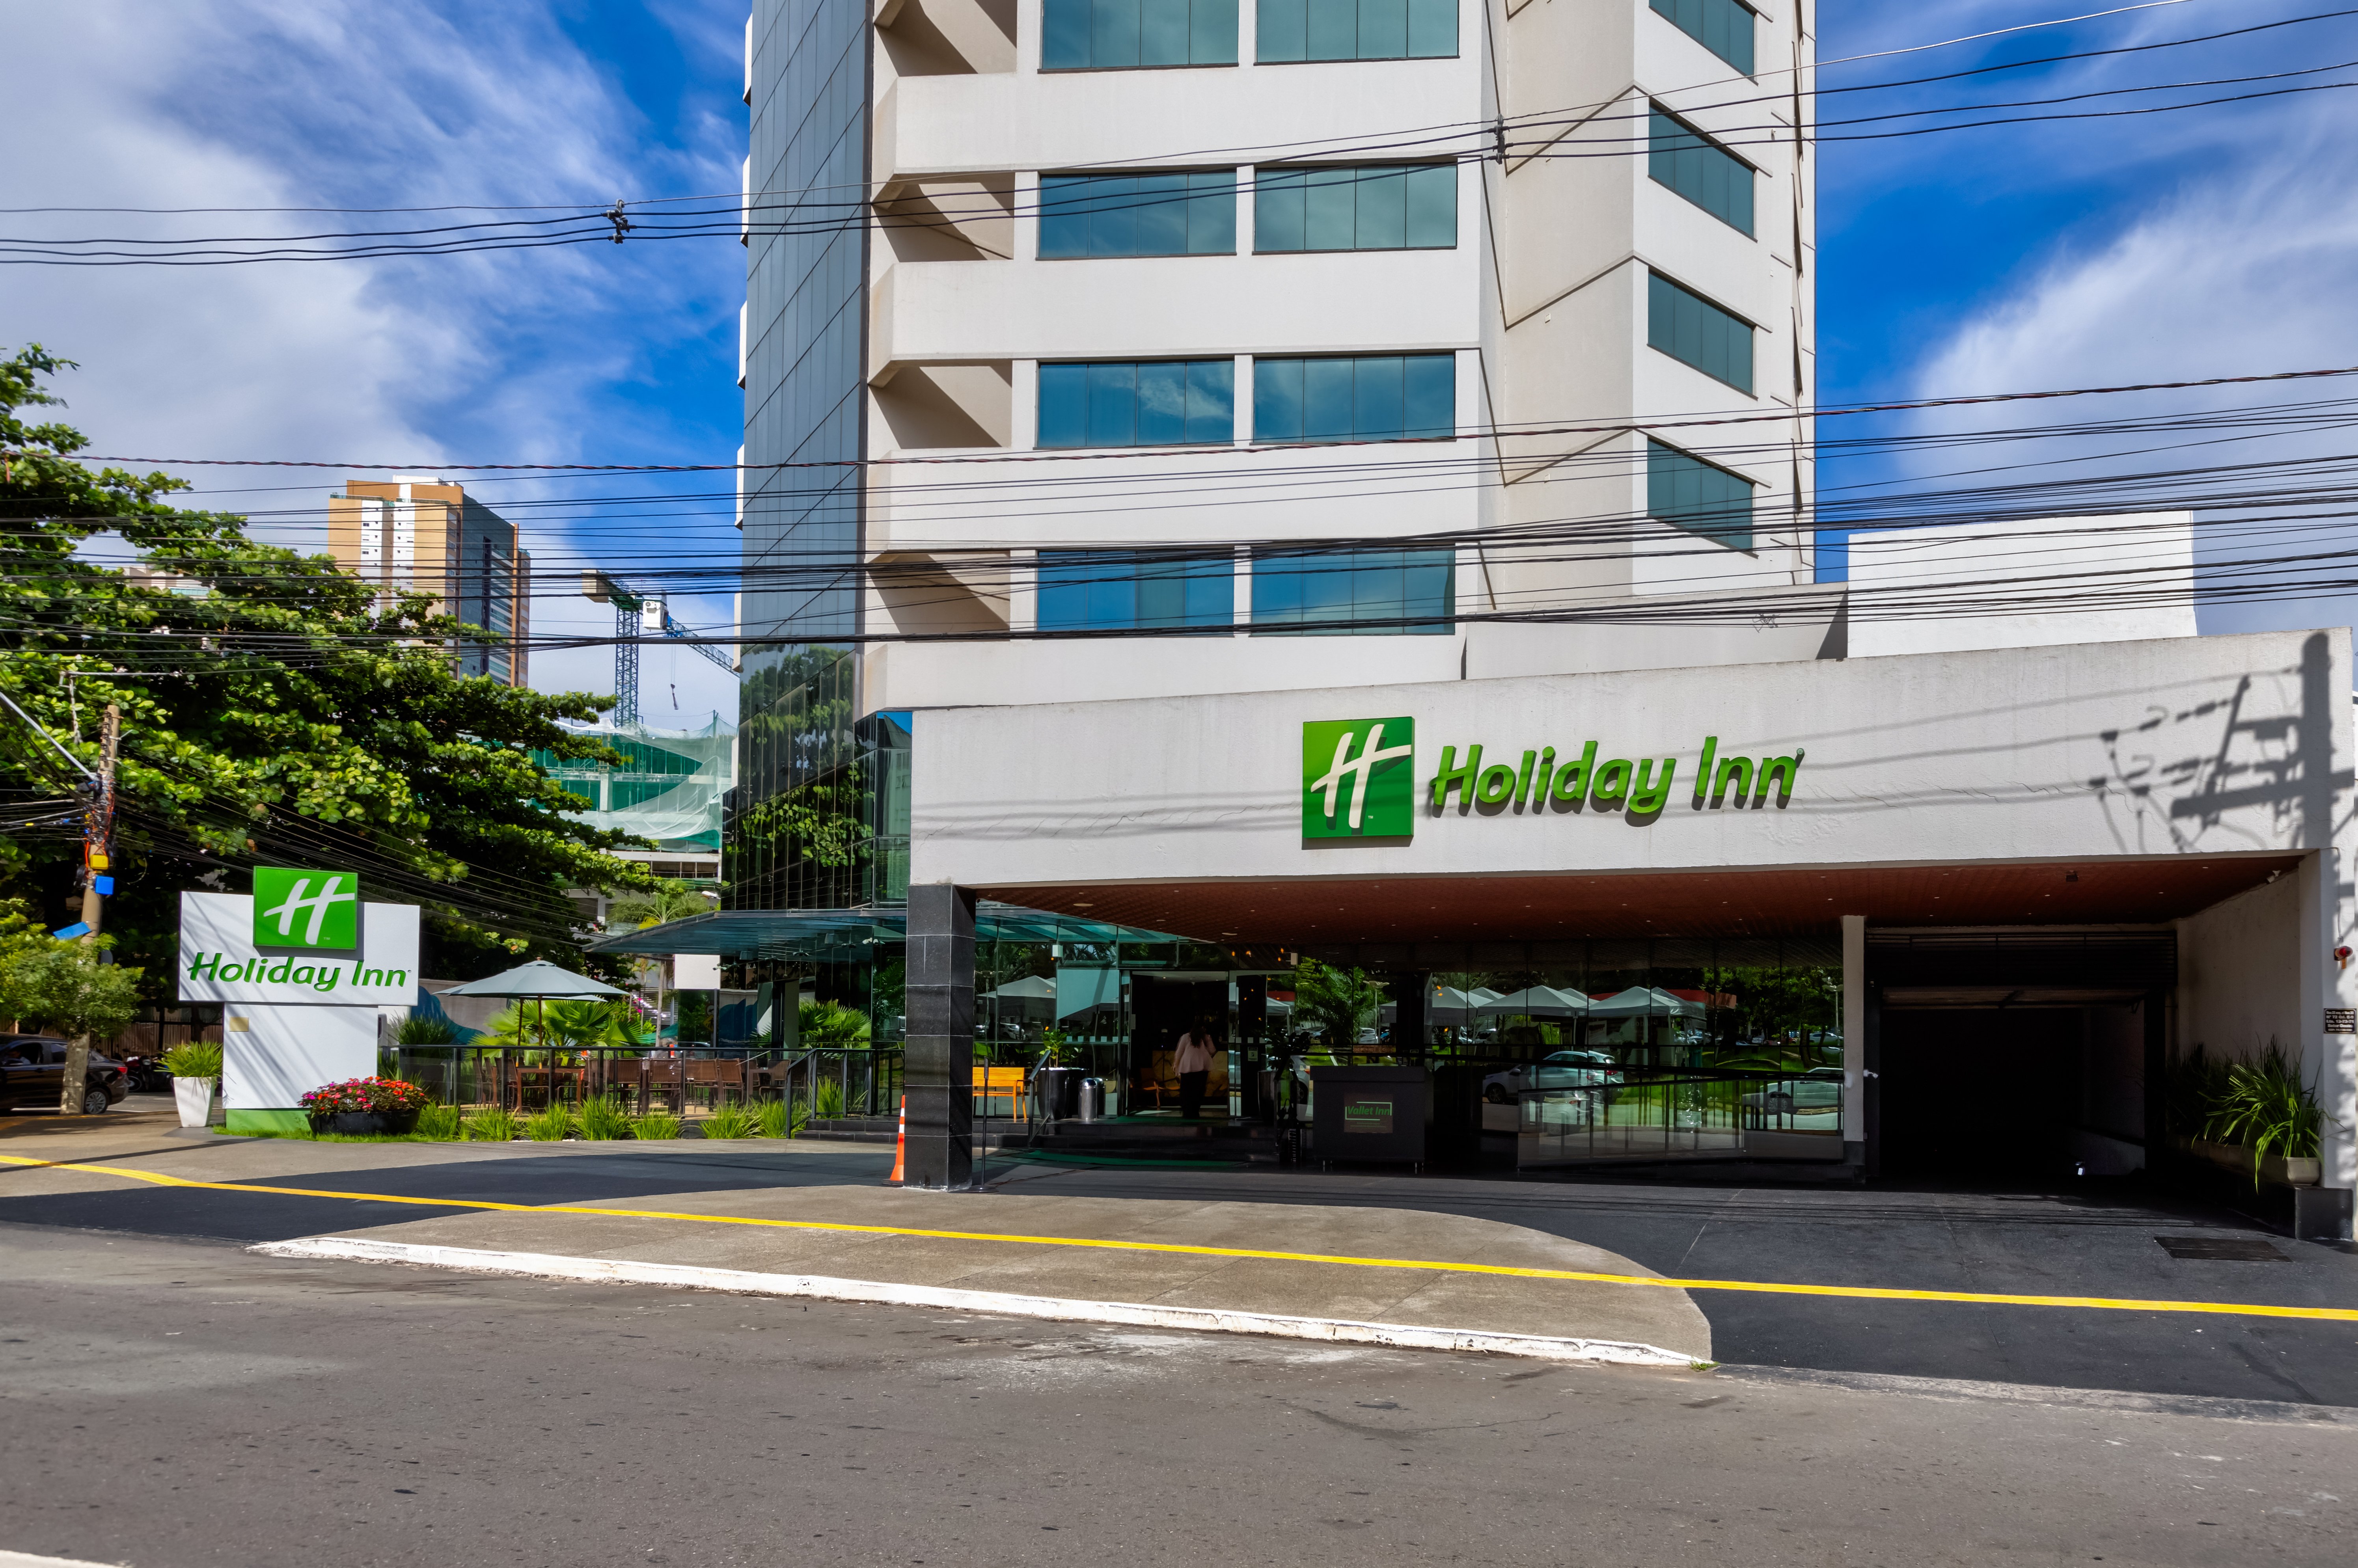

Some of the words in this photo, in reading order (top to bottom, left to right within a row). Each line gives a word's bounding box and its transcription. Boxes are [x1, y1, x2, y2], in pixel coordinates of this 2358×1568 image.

[1310, 724, 1411, 828] H
[1429, 741, 1677, 814] Holiday
[1696, 736, 1797, 797] Inn
[263, 877, 354, 945] H
[187, 952, 341, 992] Holiday
[352, 959, 406, 987] Inn
[1348, 1106, 1374, 1115] Vallet
[1375, 1106, 1390, 1115] Inn
